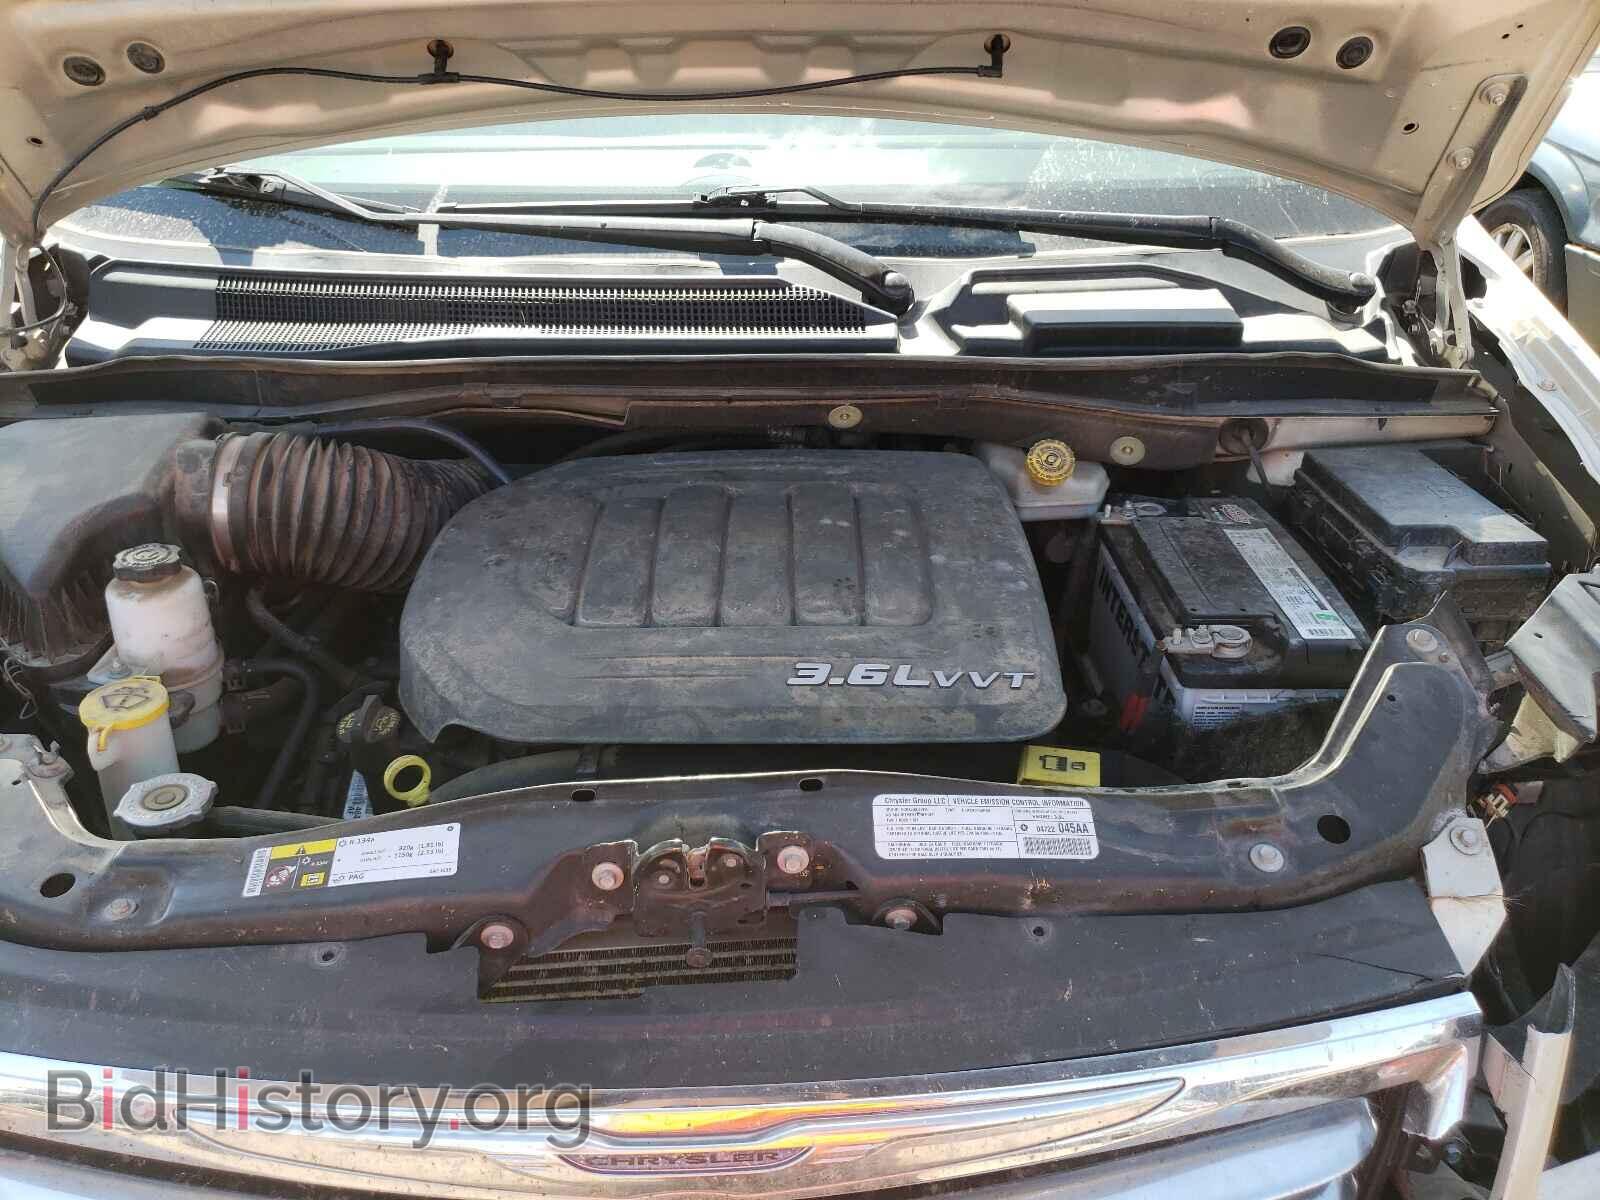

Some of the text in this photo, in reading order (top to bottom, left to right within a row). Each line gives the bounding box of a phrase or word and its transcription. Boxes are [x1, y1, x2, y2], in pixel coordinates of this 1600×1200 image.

[884, 796, 911, 805] Chrysler
[912, 796, 932, 804] Group
[952, 797, 979, 805] VEHICLE
[980, 798, 1010, 806] EMISSION
[1042, 799, 1084, 807] INFORMATION
[1058, 822, 1089, 834] 045AA
[584, 1151, 779, 1166] CHRYSLER
